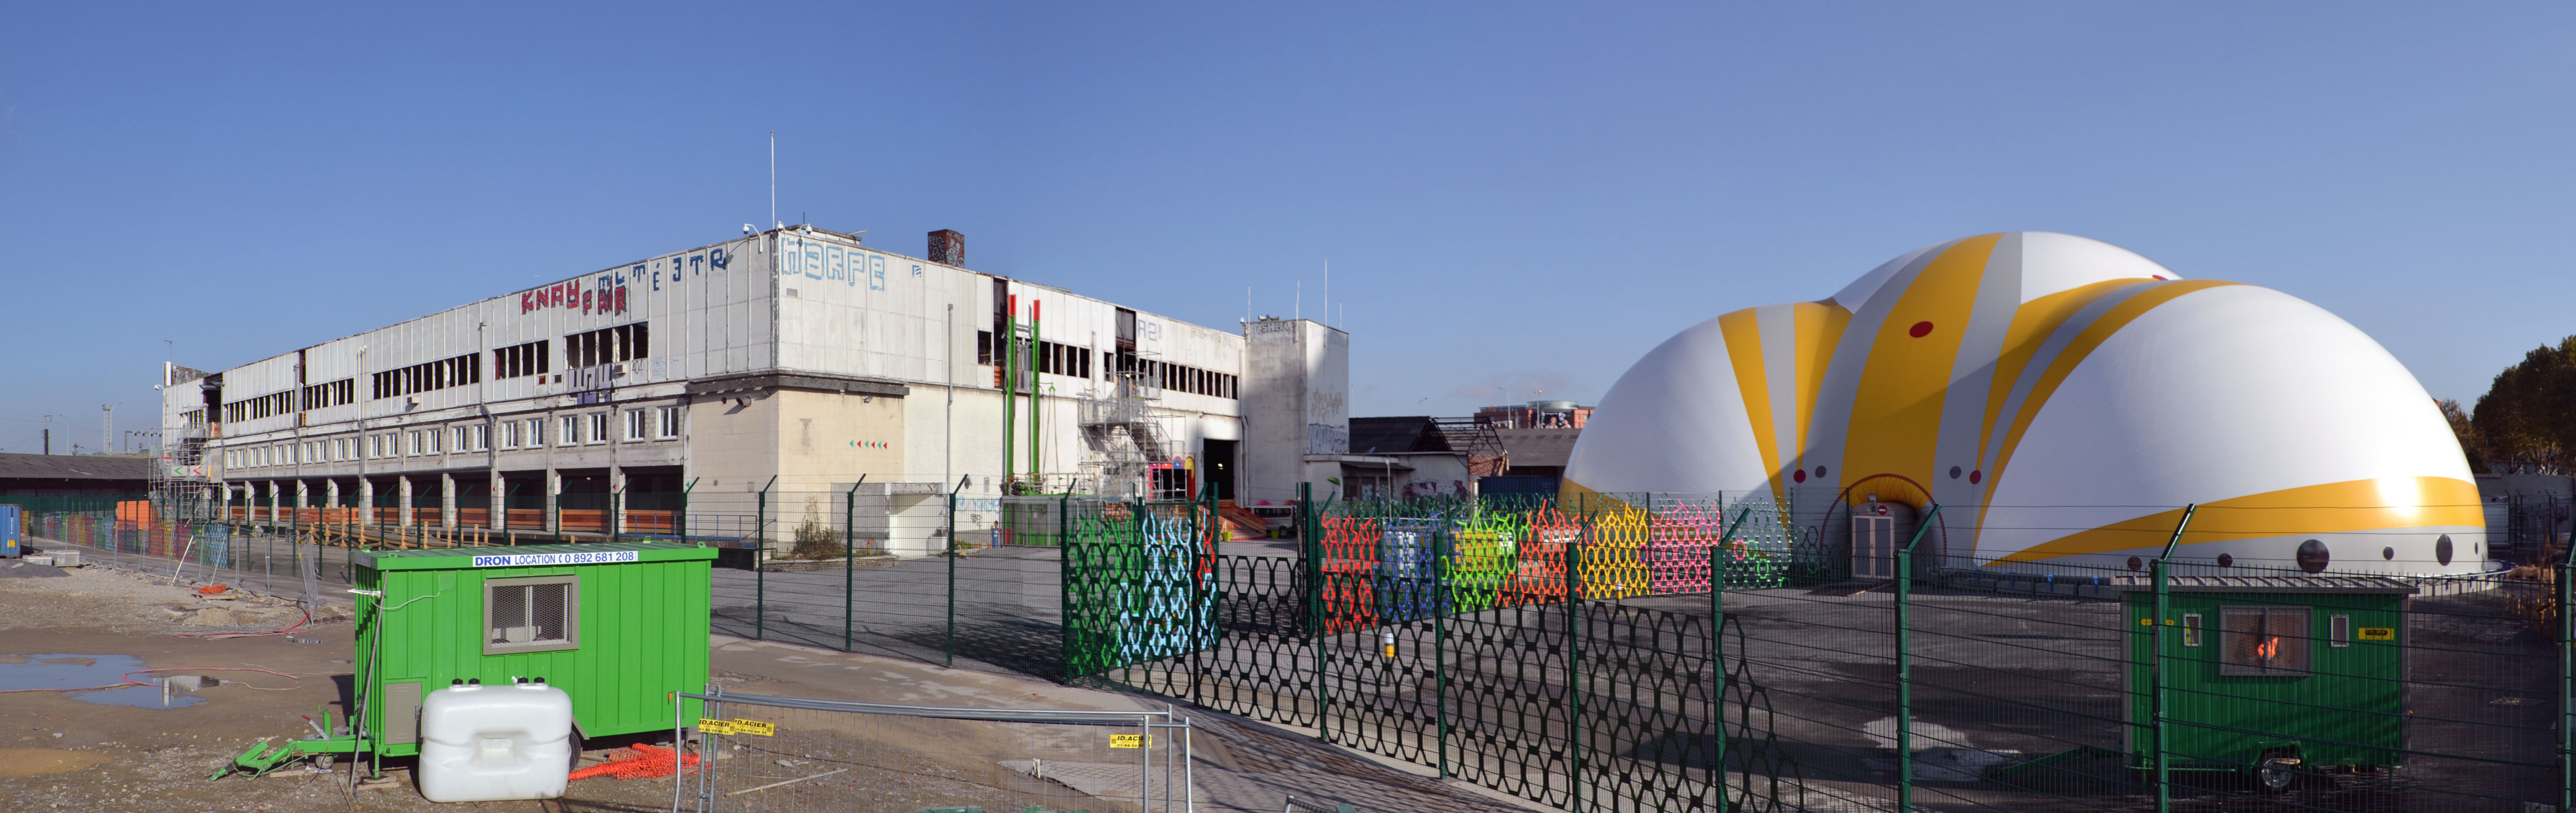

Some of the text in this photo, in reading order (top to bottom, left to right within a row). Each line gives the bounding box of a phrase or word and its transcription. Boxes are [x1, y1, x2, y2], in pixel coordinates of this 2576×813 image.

[475, 556, 511, 566] DRON
[515, 555, 555, 564] LOCATION
[574, 553, 592, 562] 892
[595, 552, 612, 562] 681
[616, 551, 634, 561] 208
[699, 719, 730, 728] ID.ACIER
